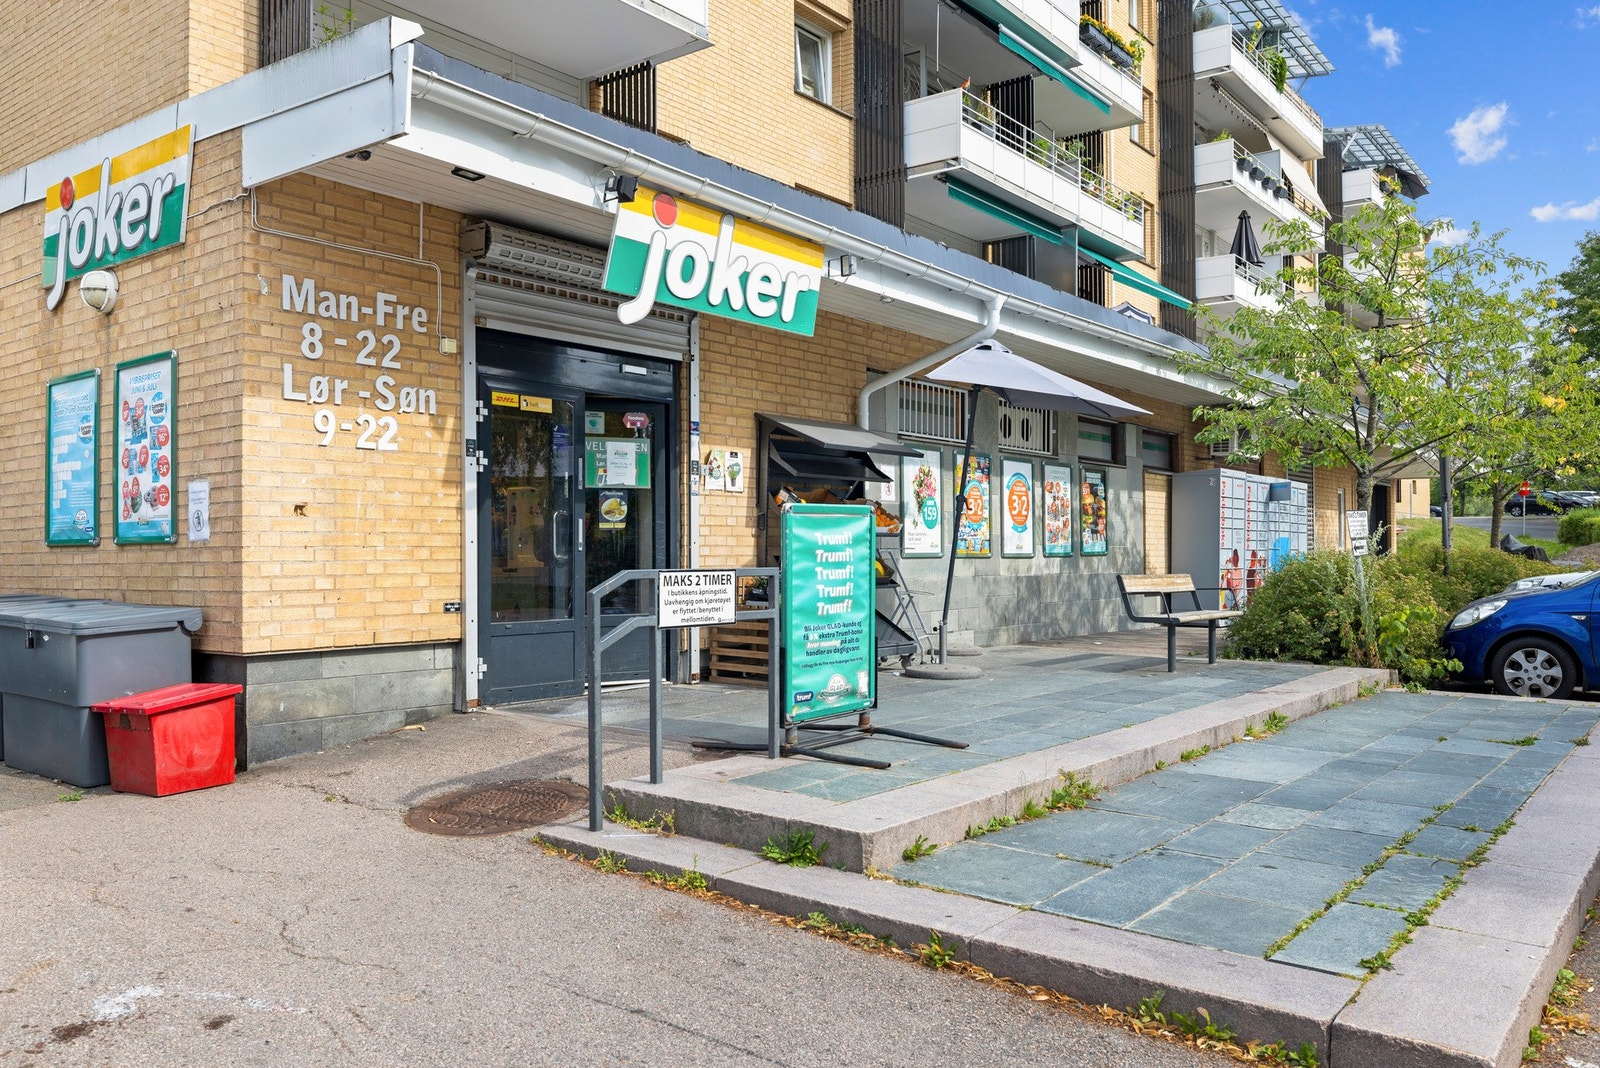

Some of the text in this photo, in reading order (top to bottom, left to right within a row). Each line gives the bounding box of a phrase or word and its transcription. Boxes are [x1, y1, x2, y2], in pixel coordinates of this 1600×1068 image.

[46, 156, 176, 312] joker
[617, 192, 811, 325] joker
[282, 273, 428, 333] Man-Fre
[1011, 495, 1028, 515] 3 2
[923, 506, 937, 521] 159
[814, 531, 853, 545] Trumf!
[815, 547, 854, 563] Trumf!
[814, 565, 854, 580] Trumf!
[663, 574, 732, 587] MAKS 2 TIMER
[816, 581, 854, 598] Trumf!
[664, 599, 695, 607] Uavhengig
[704, 597, 731, 605] kjøretøyet
[816, 599, 853, 616] Trumf!
[812, 624, 826, 632] Joker
[826, 621, 857, 630] GLAD-kunde
[820, 640, 841, 648] mandag
[840, 637, 847, 645] på
[829, 684, 843, 692] GLAD
[796, 693, 812, 701] trumf
